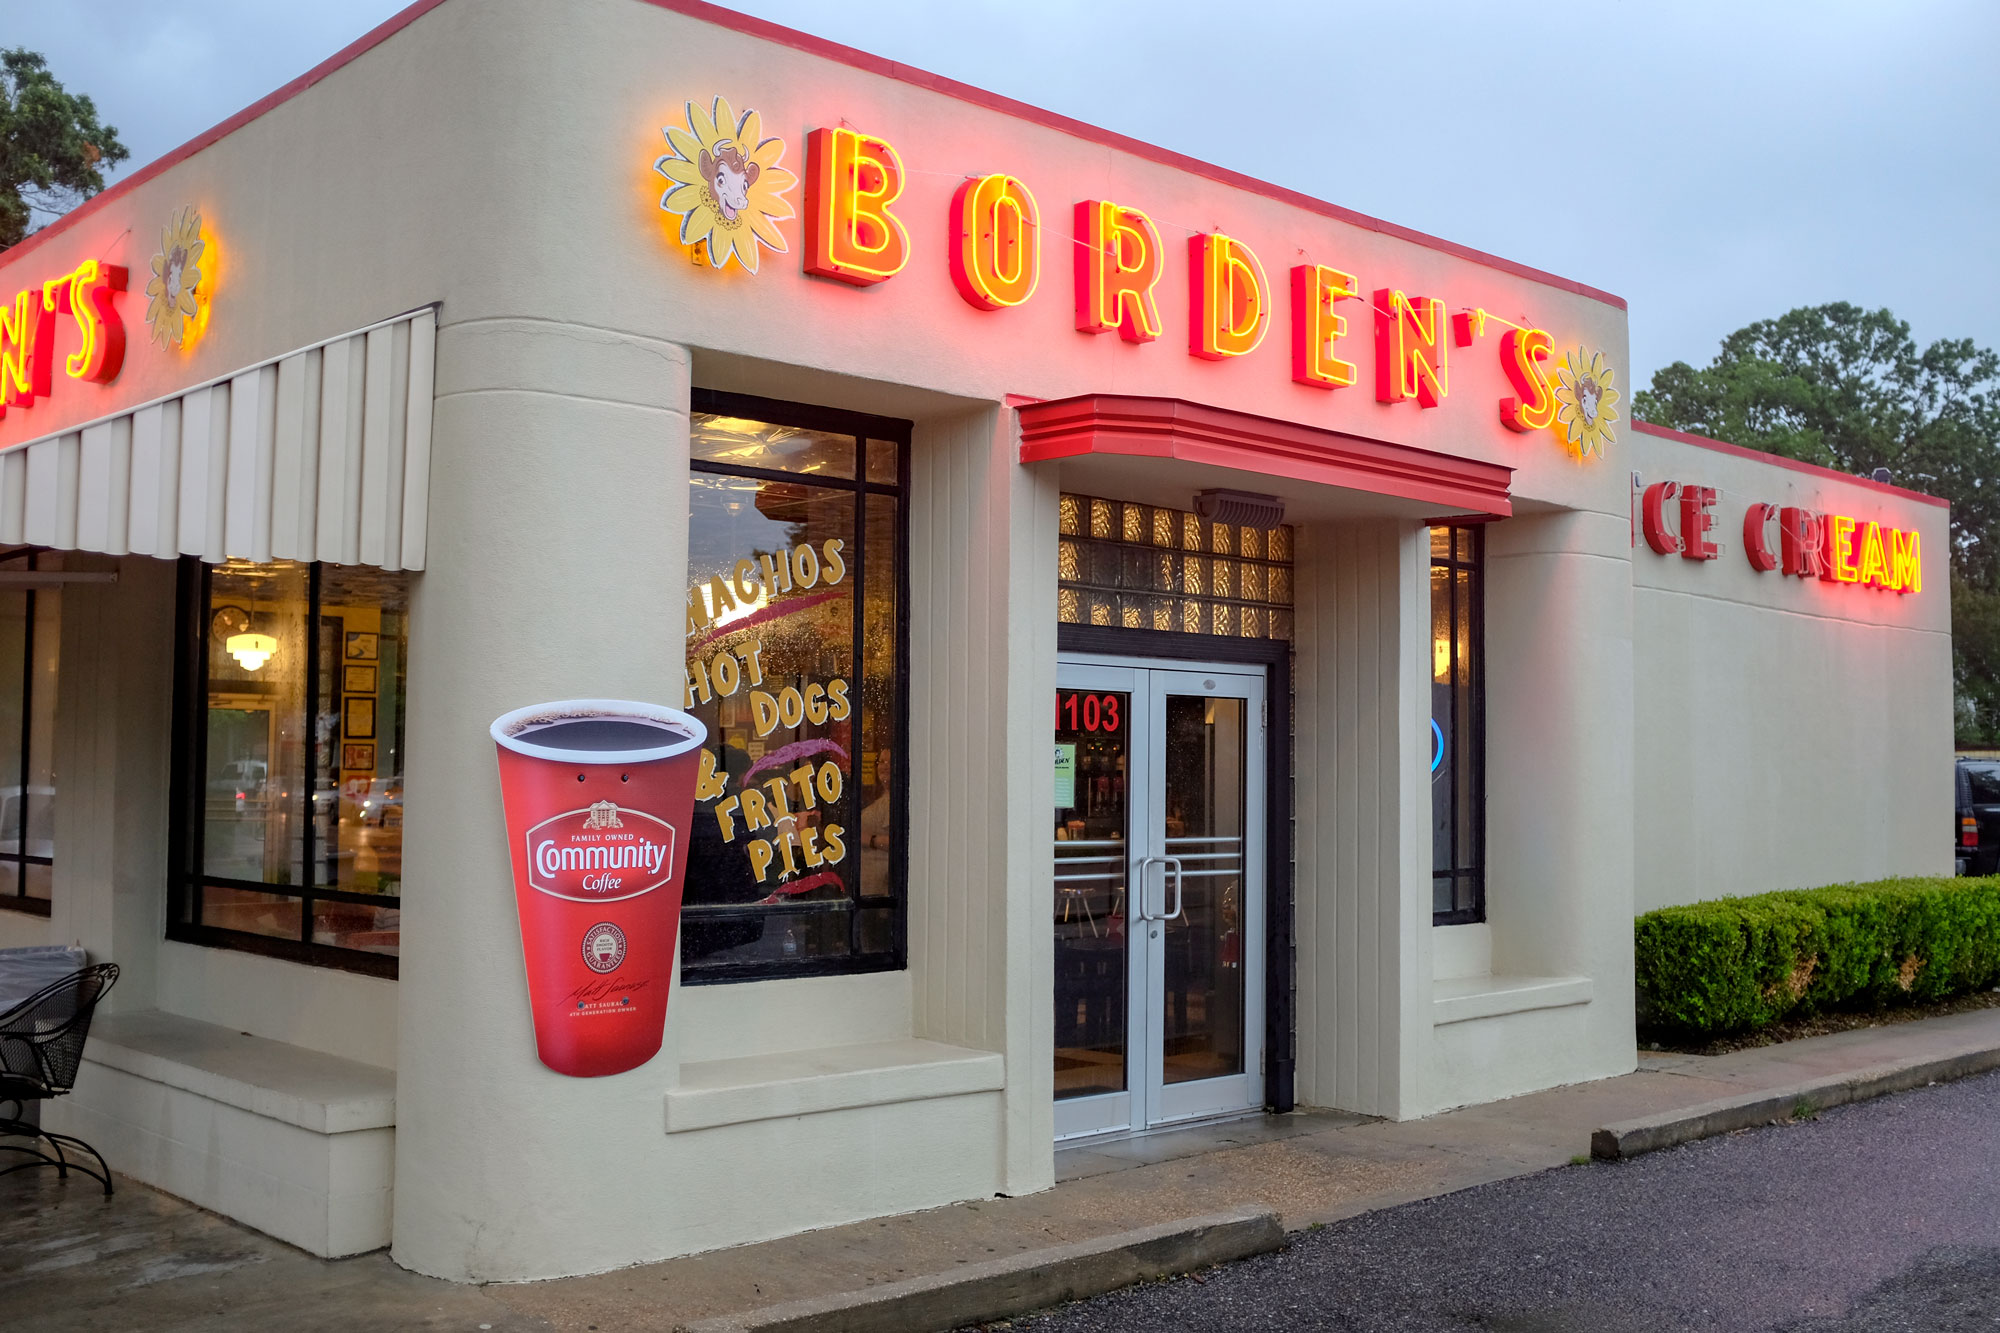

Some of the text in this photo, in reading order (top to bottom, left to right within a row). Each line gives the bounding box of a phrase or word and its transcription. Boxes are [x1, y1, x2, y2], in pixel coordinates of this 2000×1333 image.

[803, 127, 1556, 432] BORDEN'S
[1630, 472, 1922, 594] CE CREAM
[684, 639, 763, 709] HOT
[750, 678, 851, 737] DOGS
[695, 748, 729, 801] &
[714, 761, 843, 843] FRITO
[536, 837, 667, 879] Community
[571, 833, 634, 842] FAMILY OWNED
[747, 823, 846, 883] PIES
[582, 872, 622, 893] Coffee
[586, 926, 623, 946] SATISFACTION
[586, 950, 623, 970] GUARANTEED
[581, 1008, 616, 1016] GENERATION
